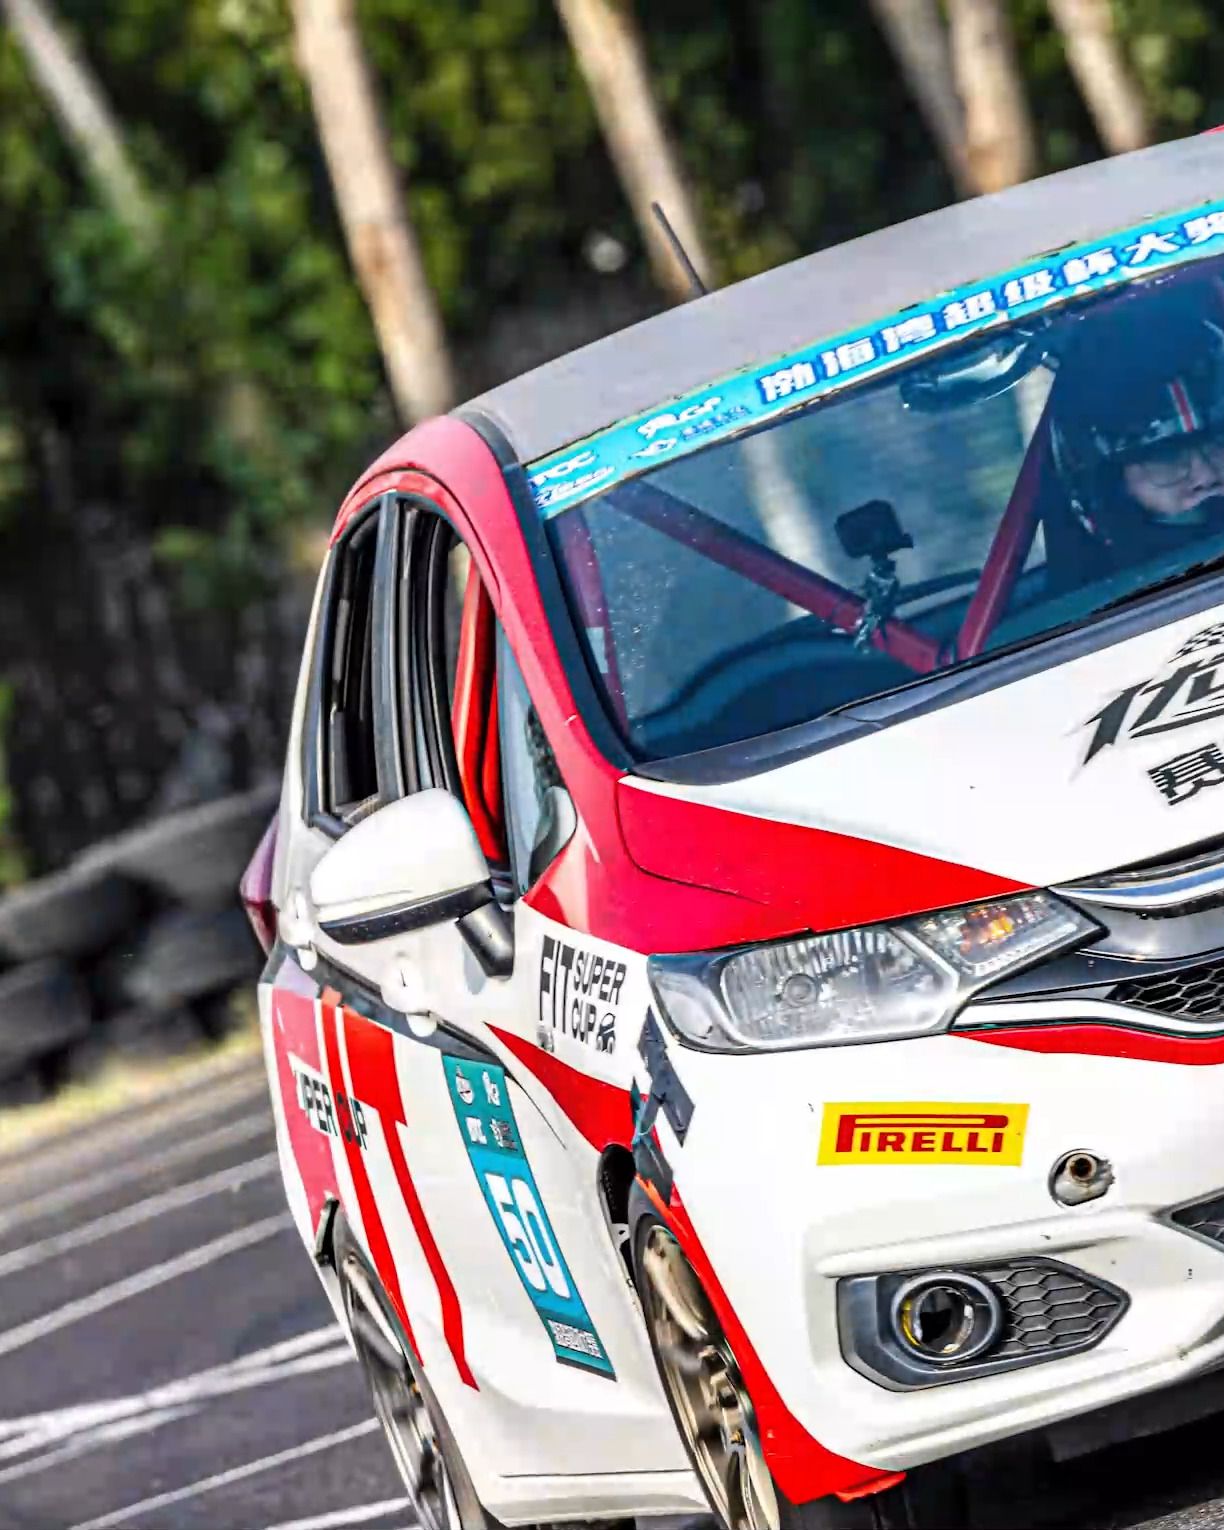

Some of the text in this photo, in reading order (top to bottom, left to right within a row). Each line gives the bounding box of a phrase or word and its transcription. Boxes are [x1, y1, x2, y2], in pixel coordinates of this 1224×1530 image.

[540, 935, 627, 1034] FIT SUPER
[571, 998, 597, 1045] CUP
[835, 1114, 1009, 1153] PIRELLI
[484, 1173, 571, 1300] 50
